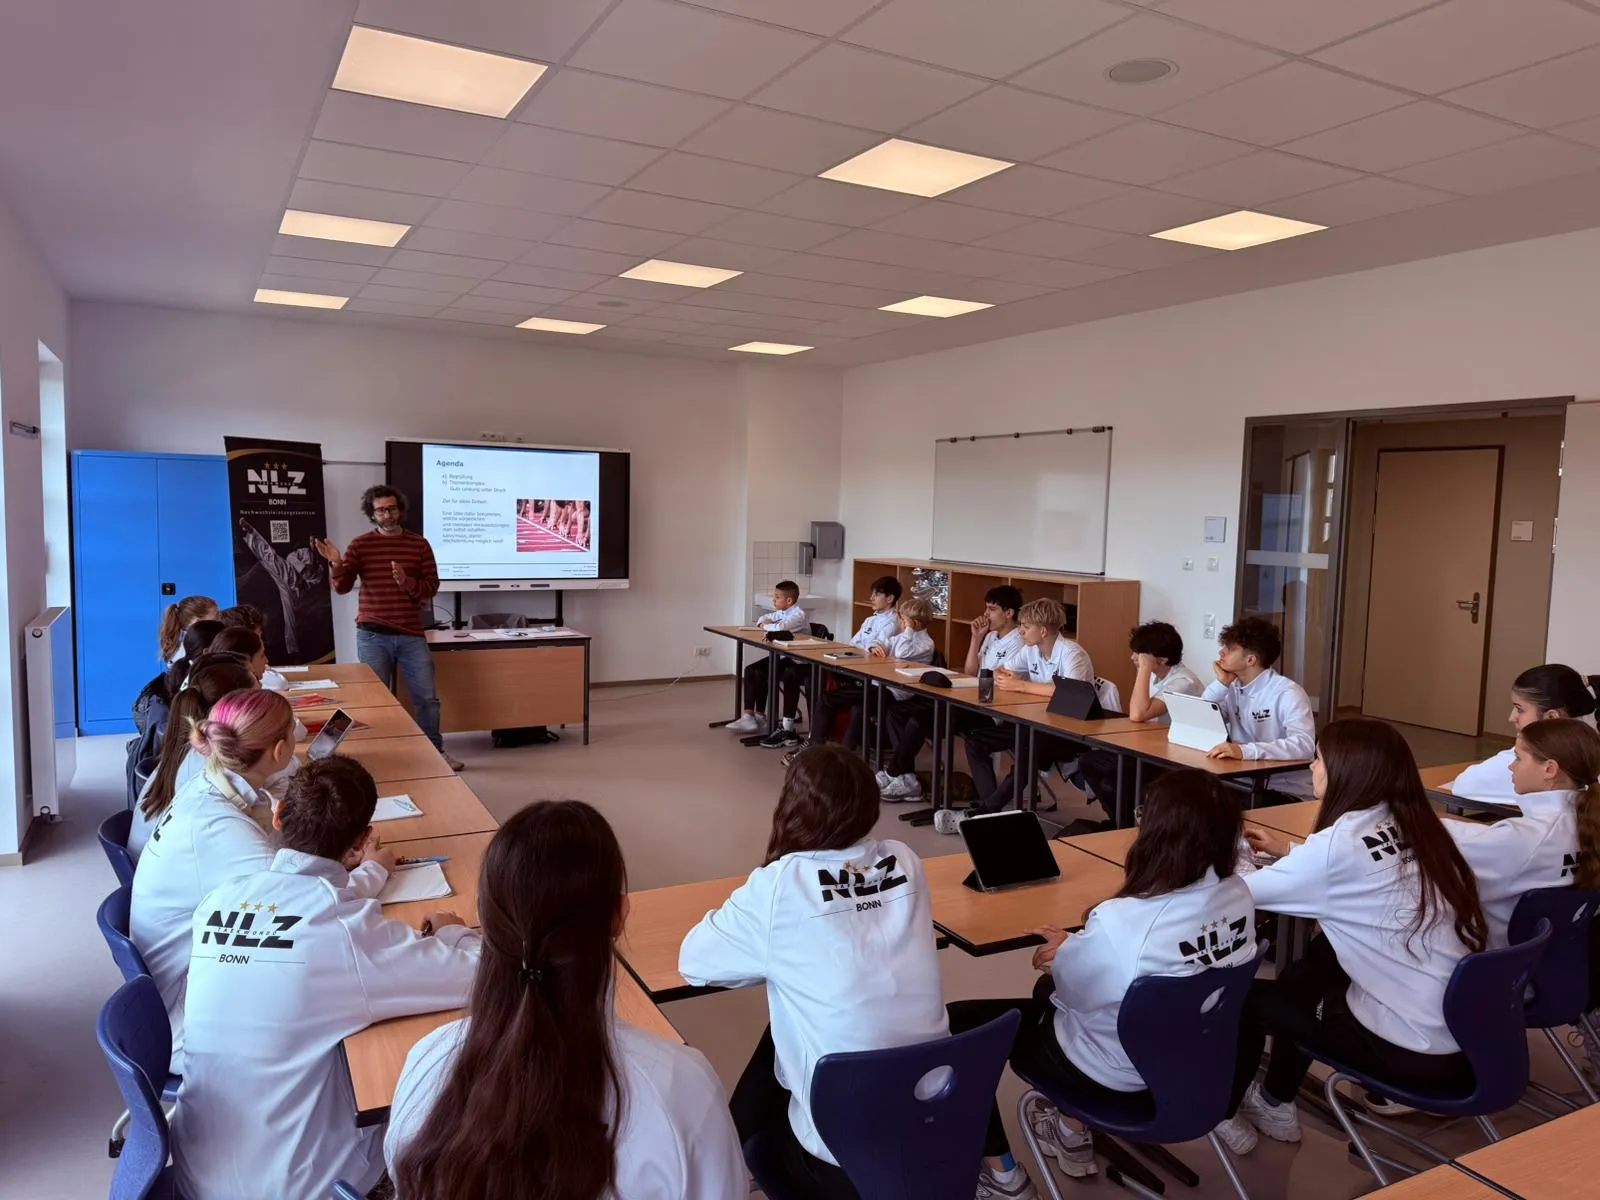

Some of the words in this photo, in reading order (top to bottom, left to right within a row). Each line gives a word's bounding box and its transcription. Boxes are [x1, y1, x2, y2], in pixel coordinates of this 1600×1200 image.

[436, 459, 464, 467] Agenda
[247, 469, 307, 495] NLZ
[818, 854, 908, 902] NLZ
[856, 900, 882, 912] BONN
[201, 910, 304, 949] NLZ
[217, 927, 278, 936] TAEKWONDO
[1178, 916, 1248, 966] NLZ
[218, 954, 250, 964] BONN
